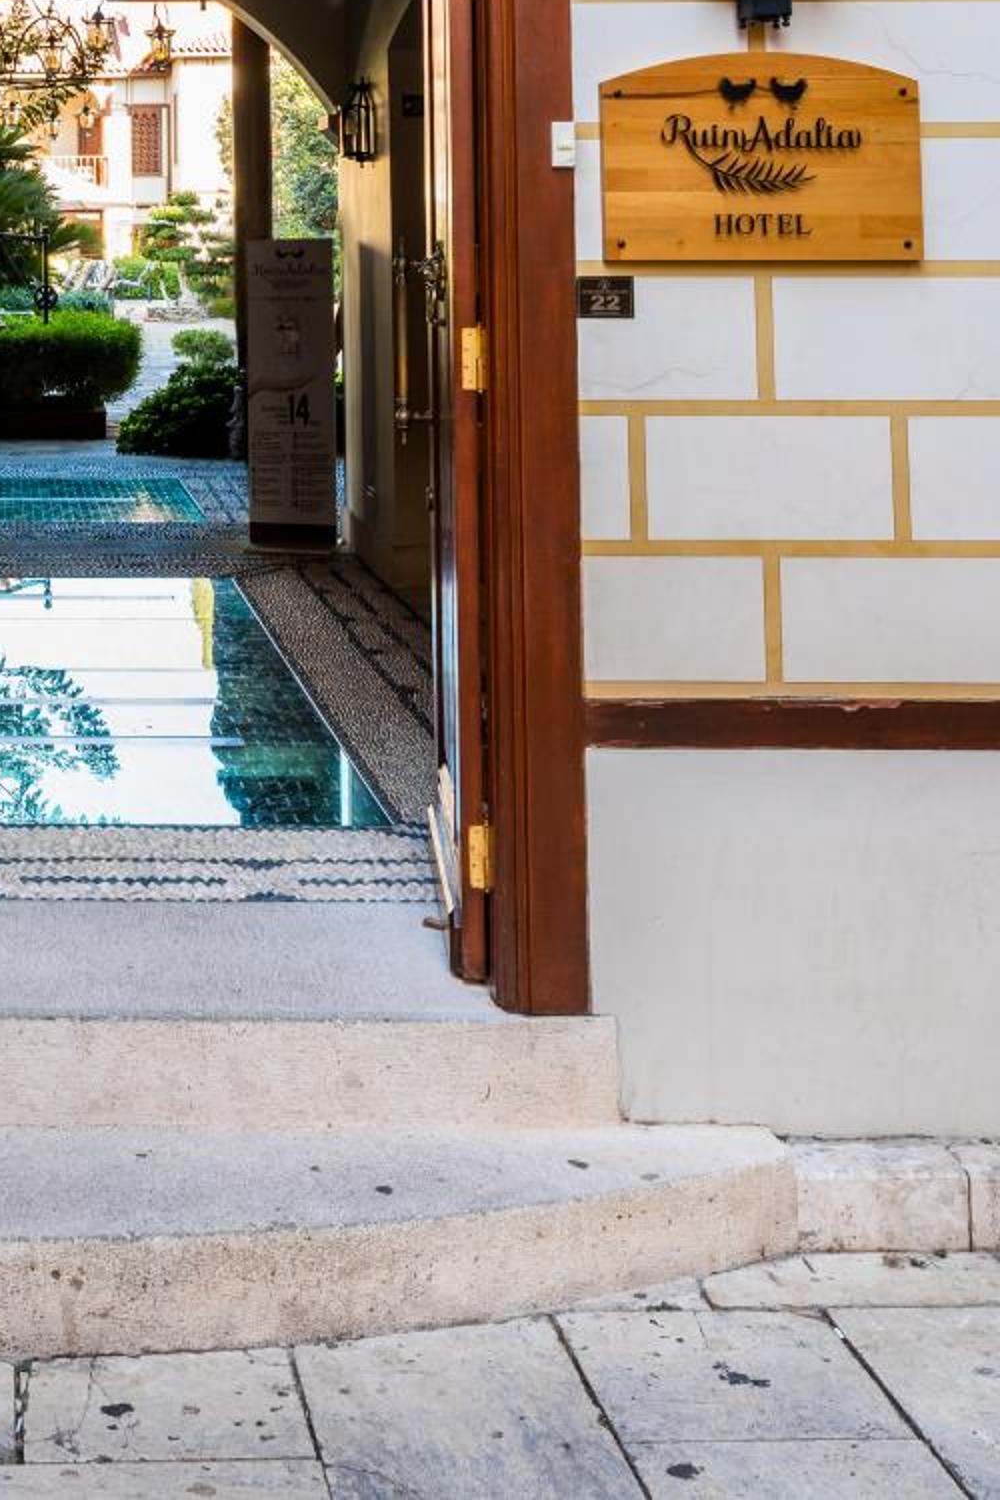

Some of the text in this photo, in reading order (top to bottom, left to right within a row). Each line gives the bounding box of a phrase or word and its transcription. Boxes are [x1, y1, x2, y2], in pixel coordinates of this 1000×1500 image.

[660, 113, 862, 154] RuinAdalia
[713, 213, 812, 237] HOTEL
[589, 295, 621, 311] 22
[288, 393, 311, 426] 14
